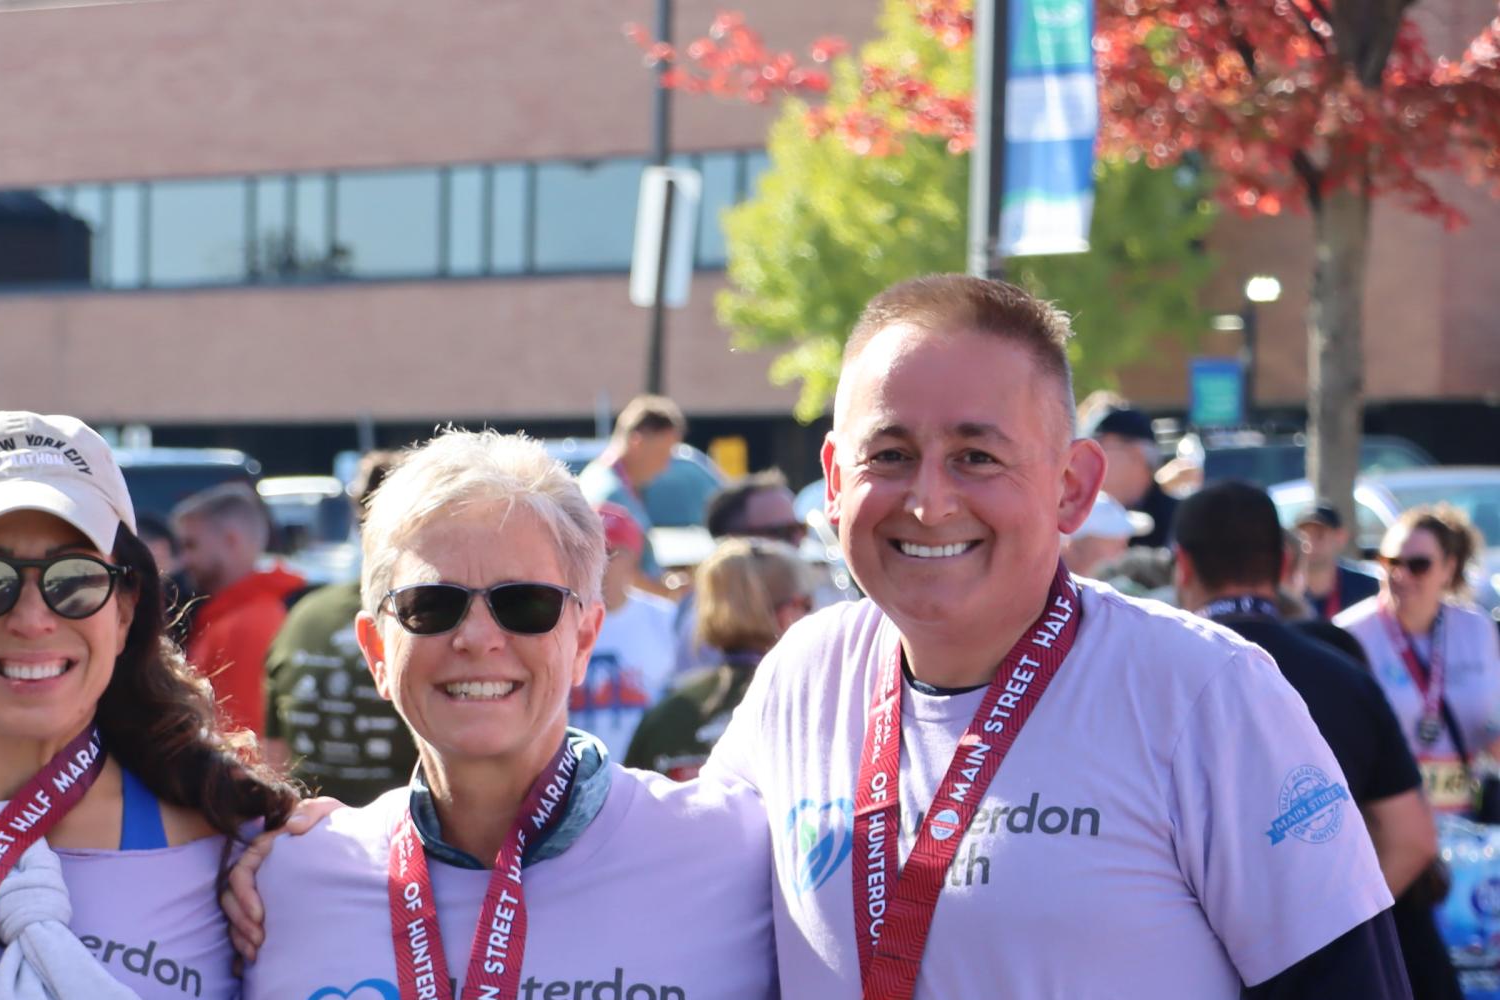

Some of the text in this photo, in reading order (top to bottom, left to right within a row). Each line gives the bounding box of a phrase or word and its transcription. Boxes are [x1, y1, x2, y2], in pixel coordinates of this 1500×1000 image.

[25, 434, 66, 450] YORK
[63, 448, 93, 476] CITY
[949, 742, 993, 803] MAIN
[984, 654, 1041, 734] STREET
[1032, 595, 1074, 649] HALF
[9, 789, 51, 832] HALF
[1275, 787, 1341, 832] MAIN STREET
[1281, 768, 1329, 810] HALF MARATHON
[1293, 802, 1340, 841] OF HUNTERDON
[867, 771, 888, 945] OF HUNTERDO
[404, 882, 422, 911] OF
[484, 890, 520, 974] STREET
